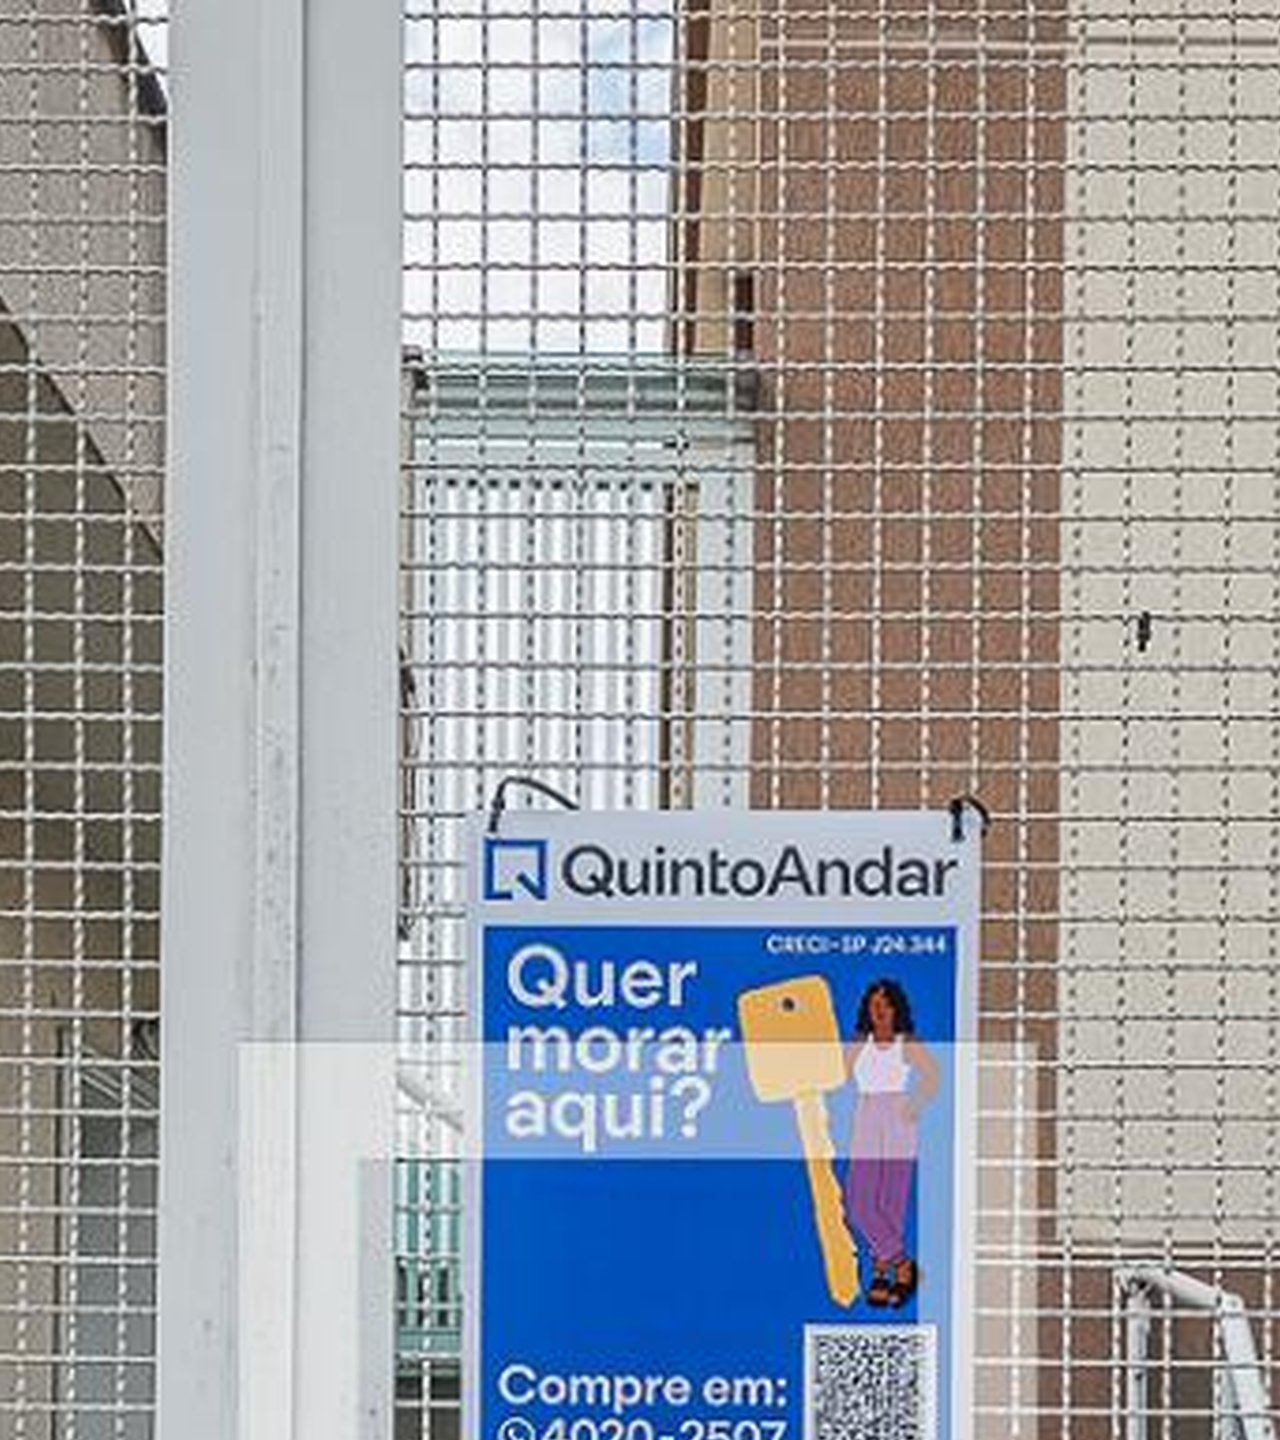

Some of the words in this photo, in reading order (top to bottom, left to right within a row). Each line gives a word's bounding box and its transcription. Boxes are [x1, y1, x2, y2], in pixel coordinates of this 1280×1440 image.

[560, 845, 958, 898] QuintoAndar
[506, 943, 698, 1010] Quer
[506, 1023, 731, 1072] morar
[505, 1075, 712, 1153] aqui?
[498, 1363, 692, 1415] Compre
[702, 1374, 788, 1408] em:
